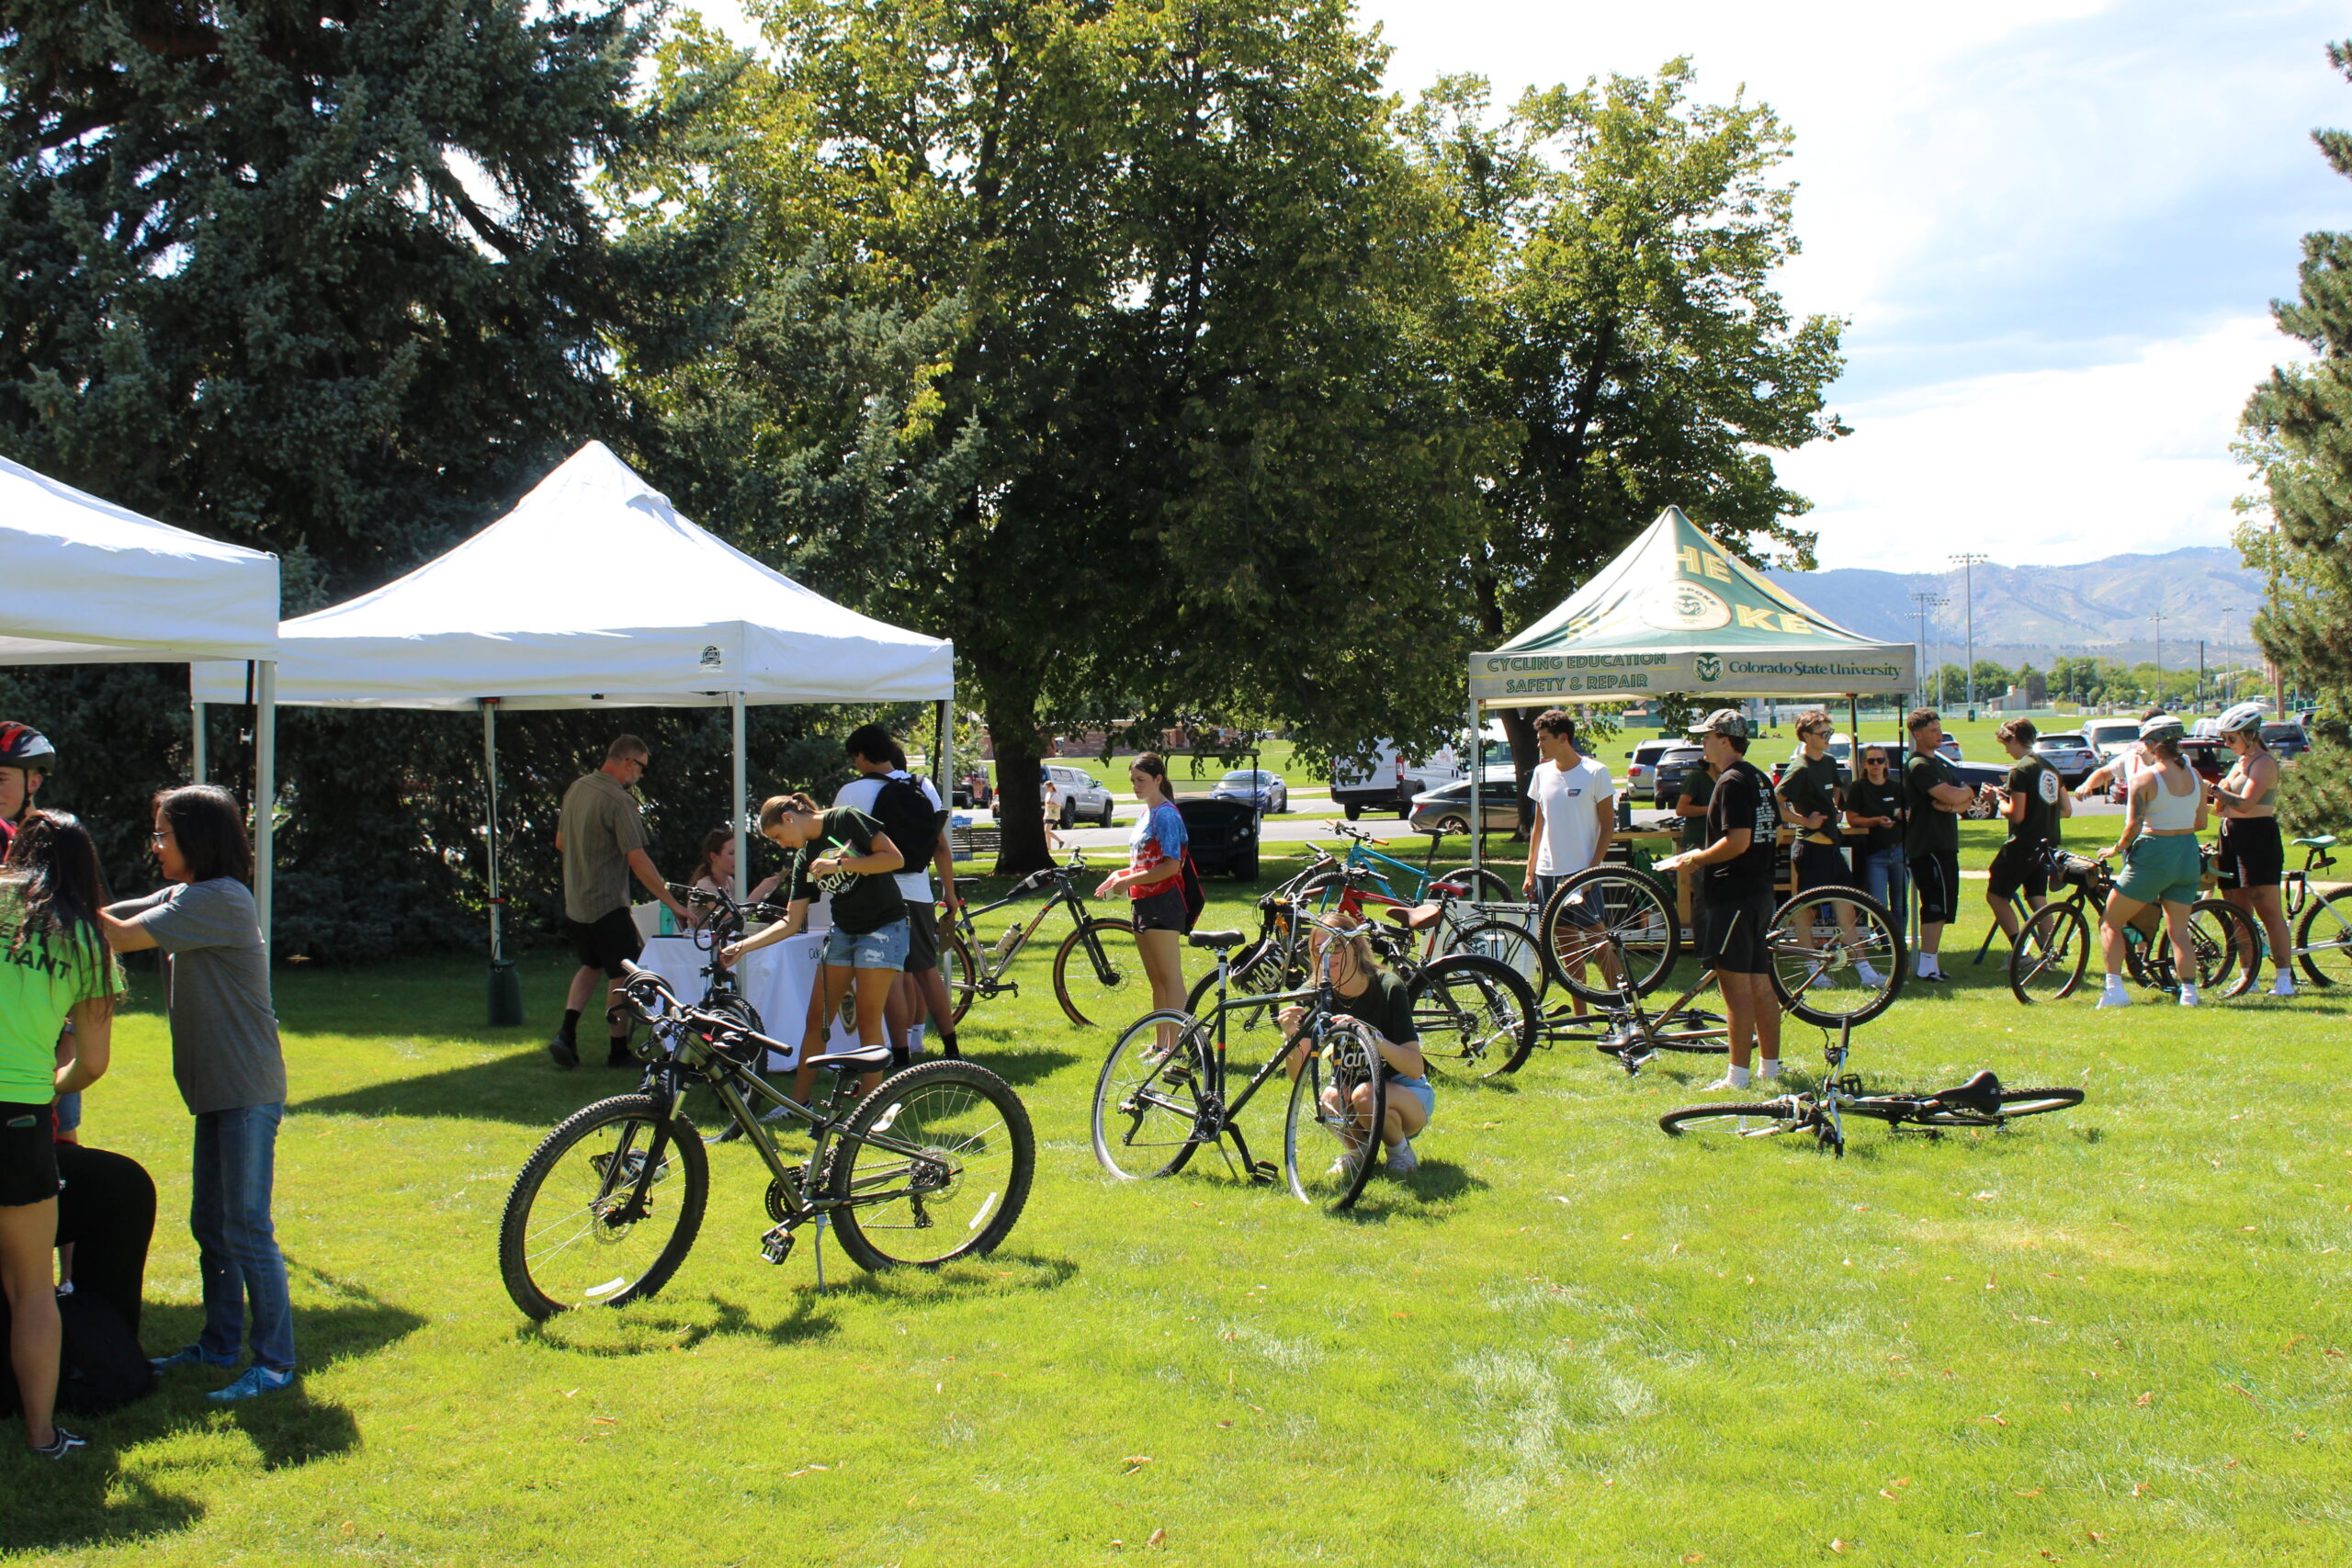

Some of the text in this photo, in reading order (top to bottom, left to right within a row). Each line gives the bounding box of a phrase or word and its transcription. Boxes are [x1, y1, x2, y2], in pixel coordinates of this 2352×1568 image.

[1487, 652, 1668, 672] CYCLING EDUCATION
[1728, 660, 1903, 681] Colorado State University
[1506, 673, 1648, 694] SAFETY & REPAIR
